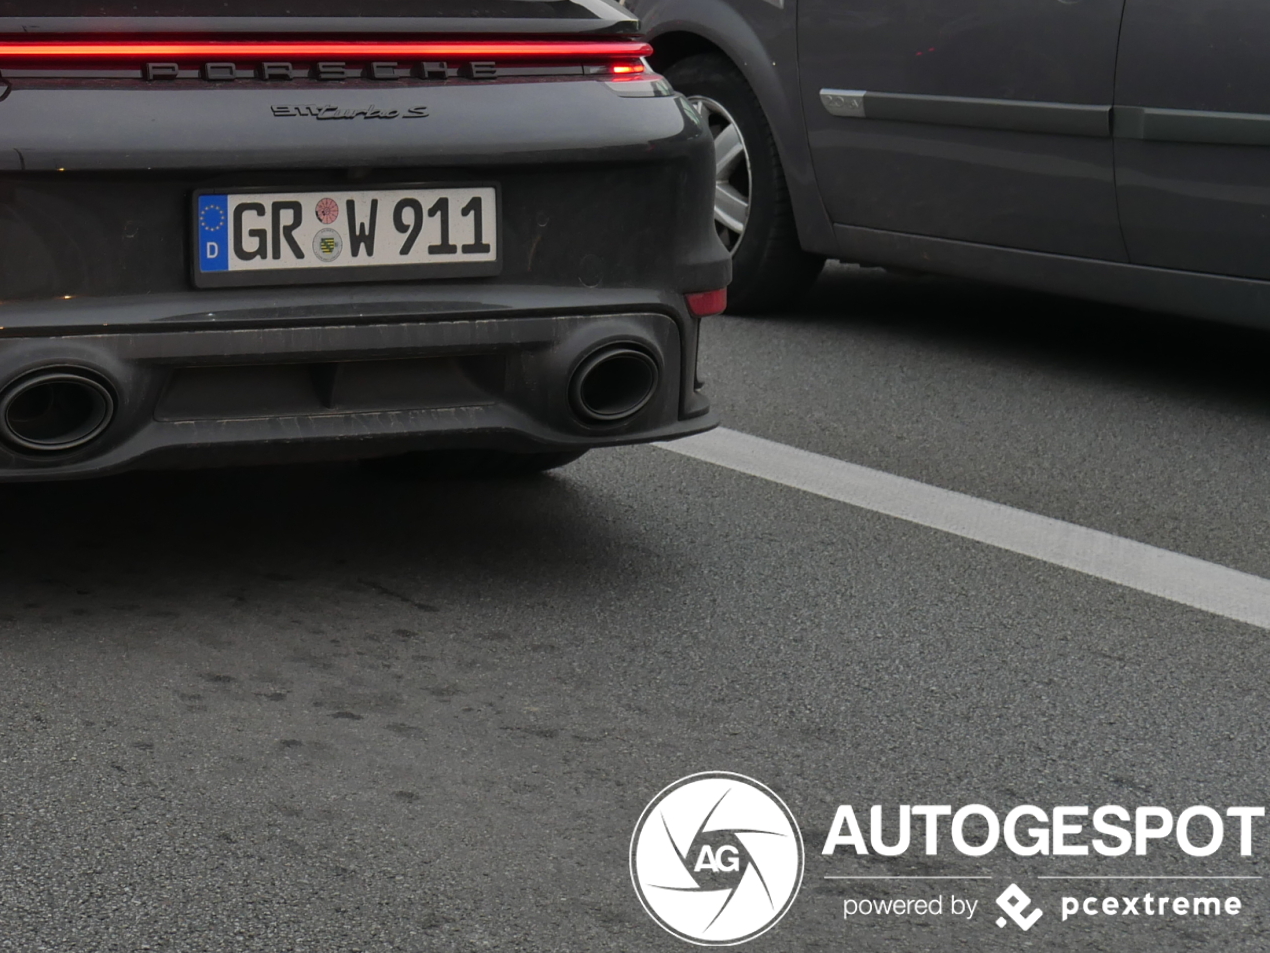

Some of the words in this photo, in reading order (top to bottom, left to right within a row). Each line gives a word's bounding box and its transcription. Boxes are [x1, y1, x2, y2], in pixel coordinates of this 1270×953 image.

[143, 61, 497, 81] PORSCHE
[232, 200, 305, 261] GR
[346, 198, 379, 257] W
[393, 196, 491, 256] 911
[206, 241, 219, 259] D
